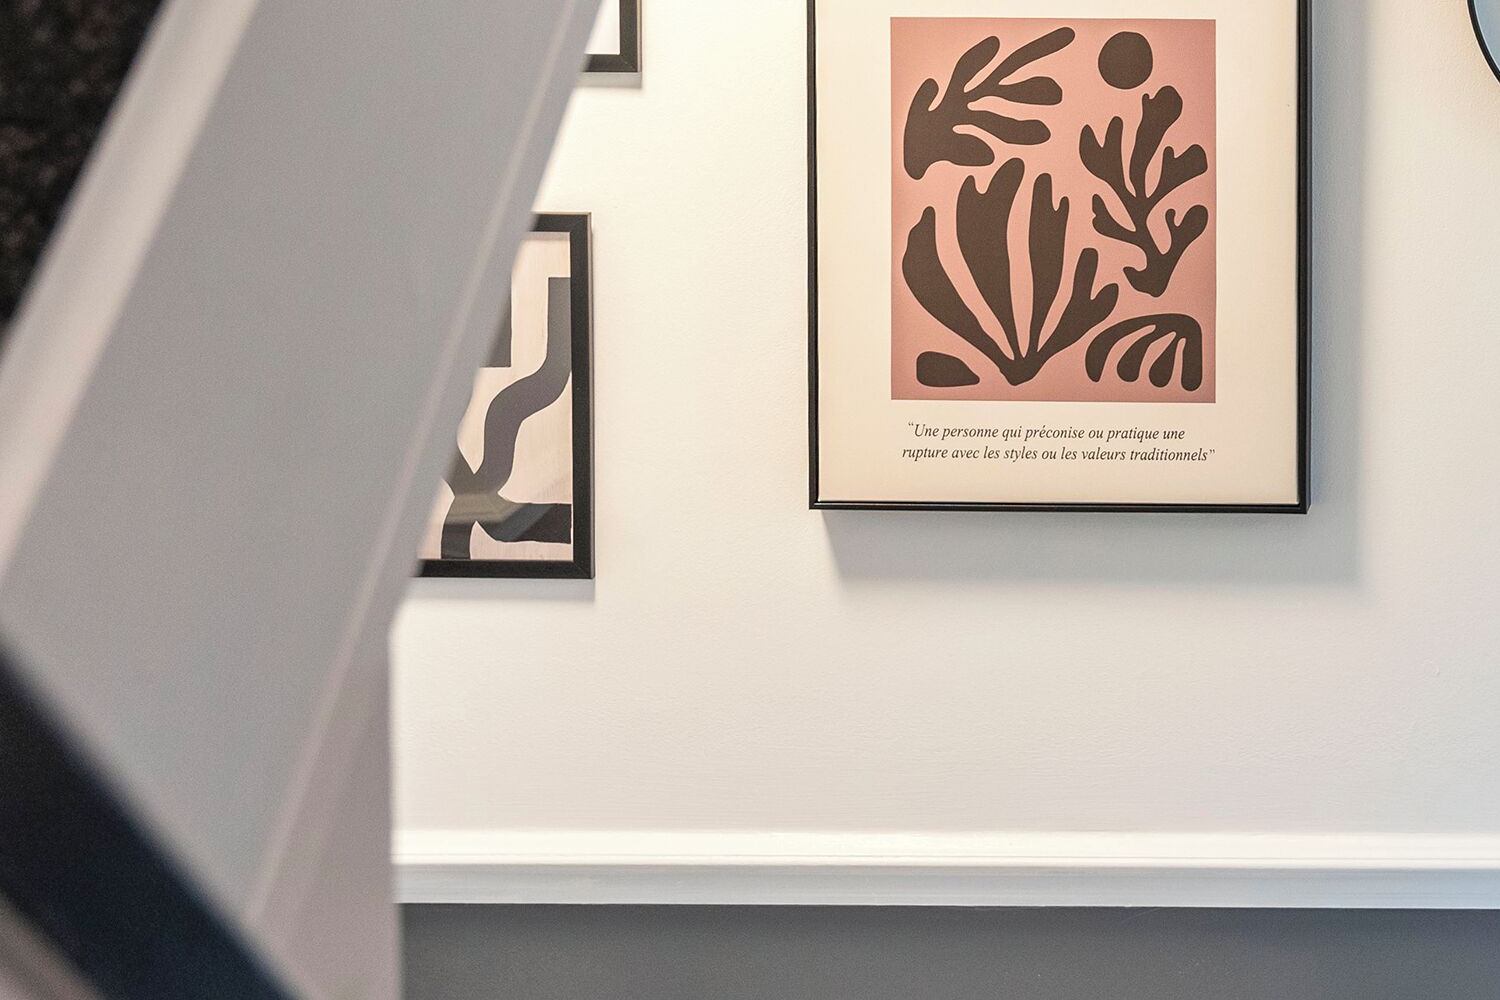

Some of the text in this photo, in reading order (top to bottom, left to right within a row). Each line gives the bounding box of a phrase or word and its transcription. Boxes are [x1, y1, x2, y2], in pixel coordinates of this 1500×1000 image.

[908, 421, 1186, 443] “Une personne qui préconise ou pratique une
[902, 446, 1216, 462] rupture avec les styles ou les valeurs traditionnels”
